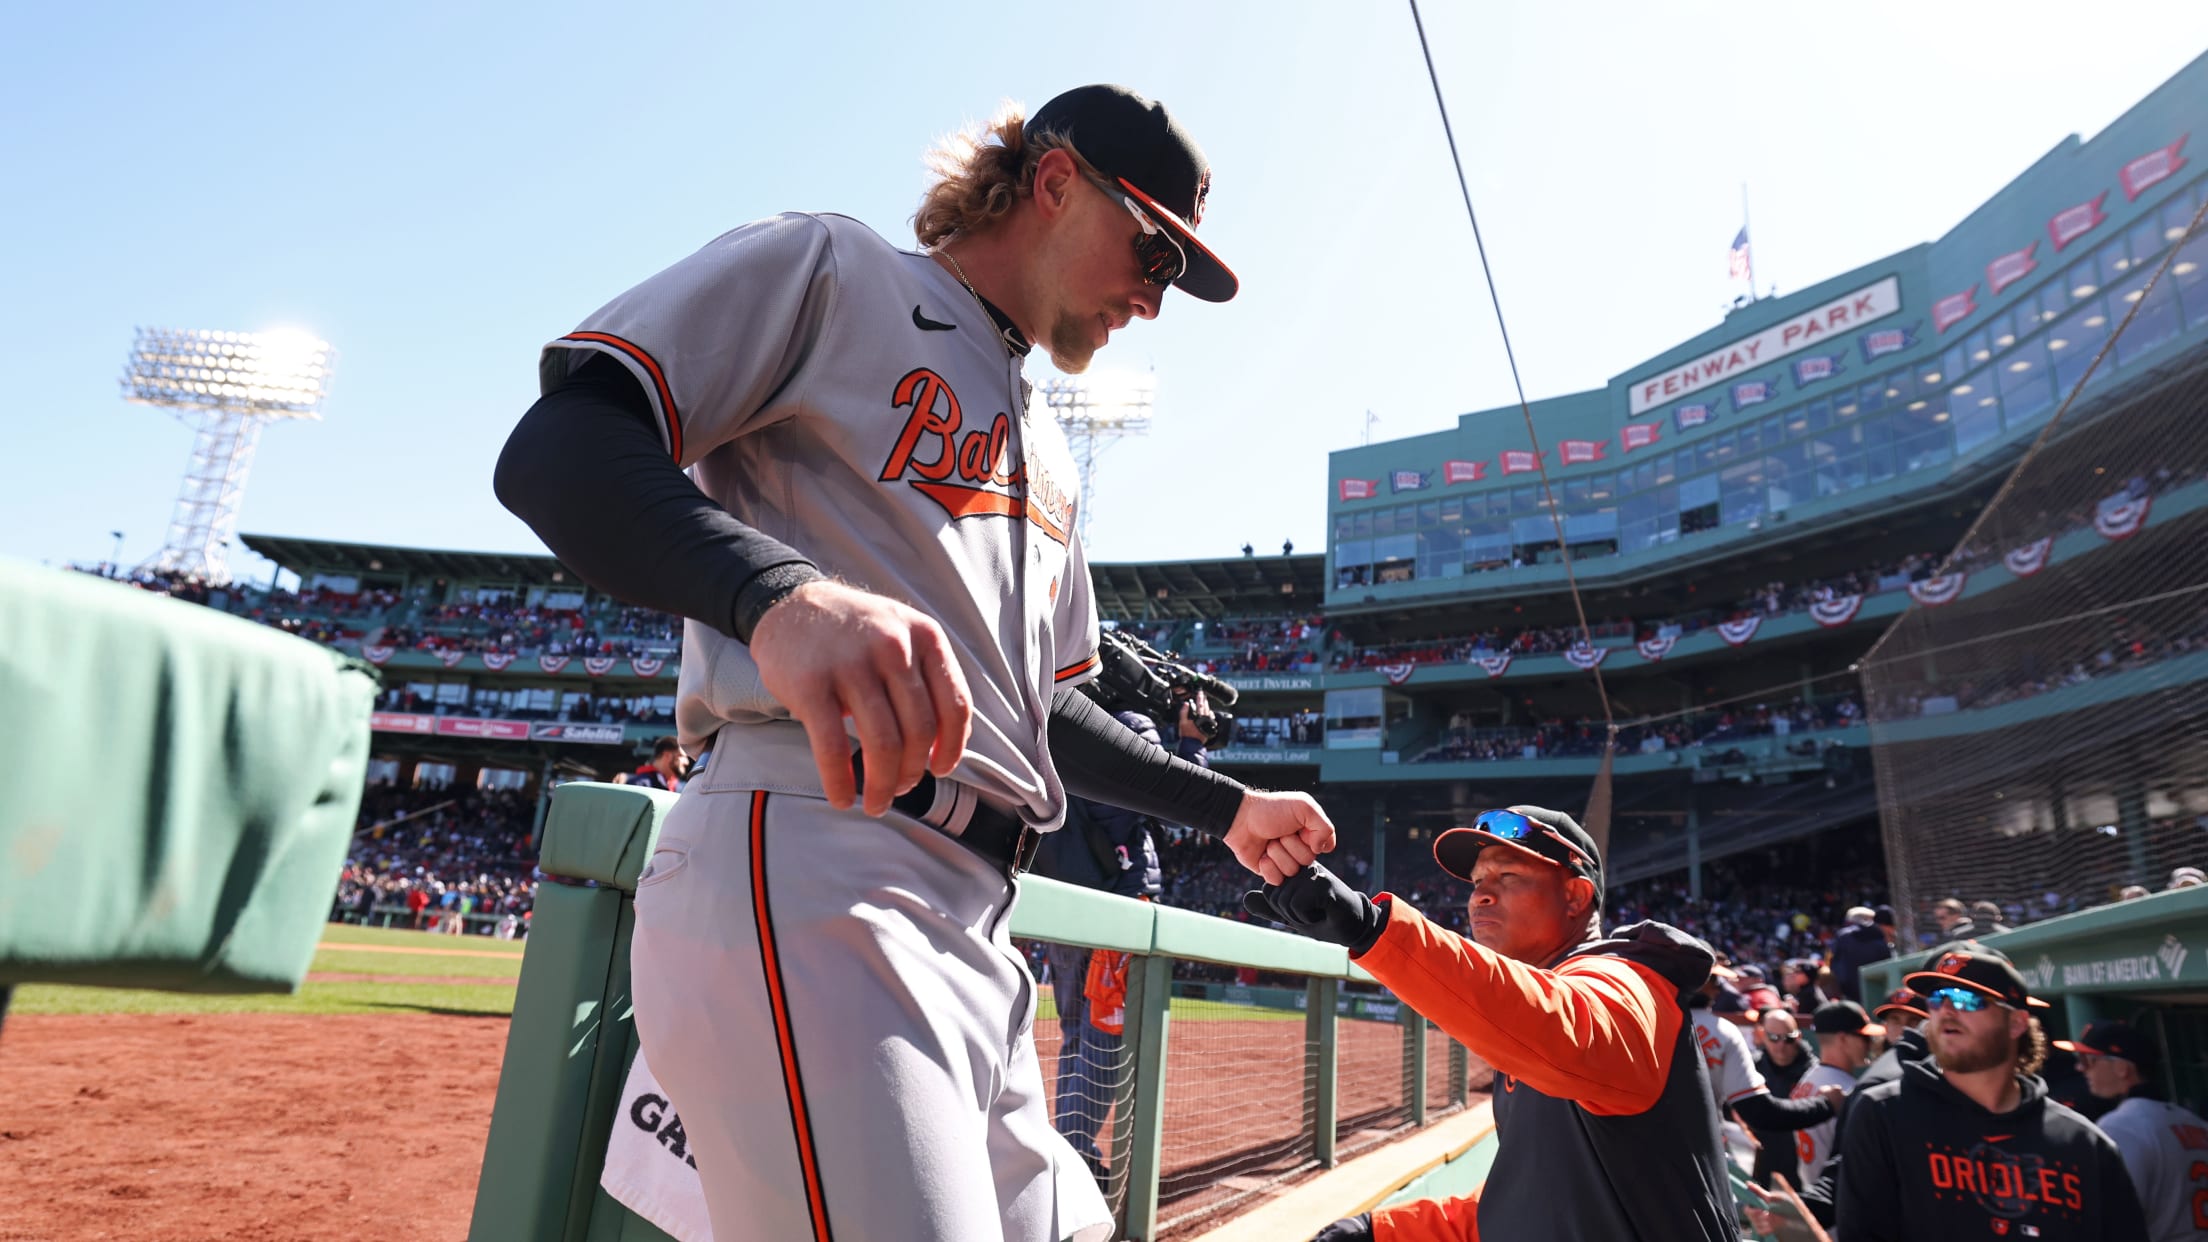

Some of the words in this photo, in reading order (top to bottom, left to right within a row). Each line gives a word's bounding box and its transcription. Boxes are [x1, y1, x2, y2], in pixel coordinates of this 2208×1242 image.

[1645, 340, 1762, 403] FENWAY
[1782, 294, 1875, 347] PARK
[1263, 677, 1312, 689] PAVILION
[562, 726, 620, 741] Safelite
[1223, 750, 1282, 763] Technologies
[1284, 750, 1310, 761] Level
[2107, 956, 2160, 982] AMERICA
[630, 1093, 698, 1171] GA
[1929, 1153, 2082, 1211] ORIOLES
